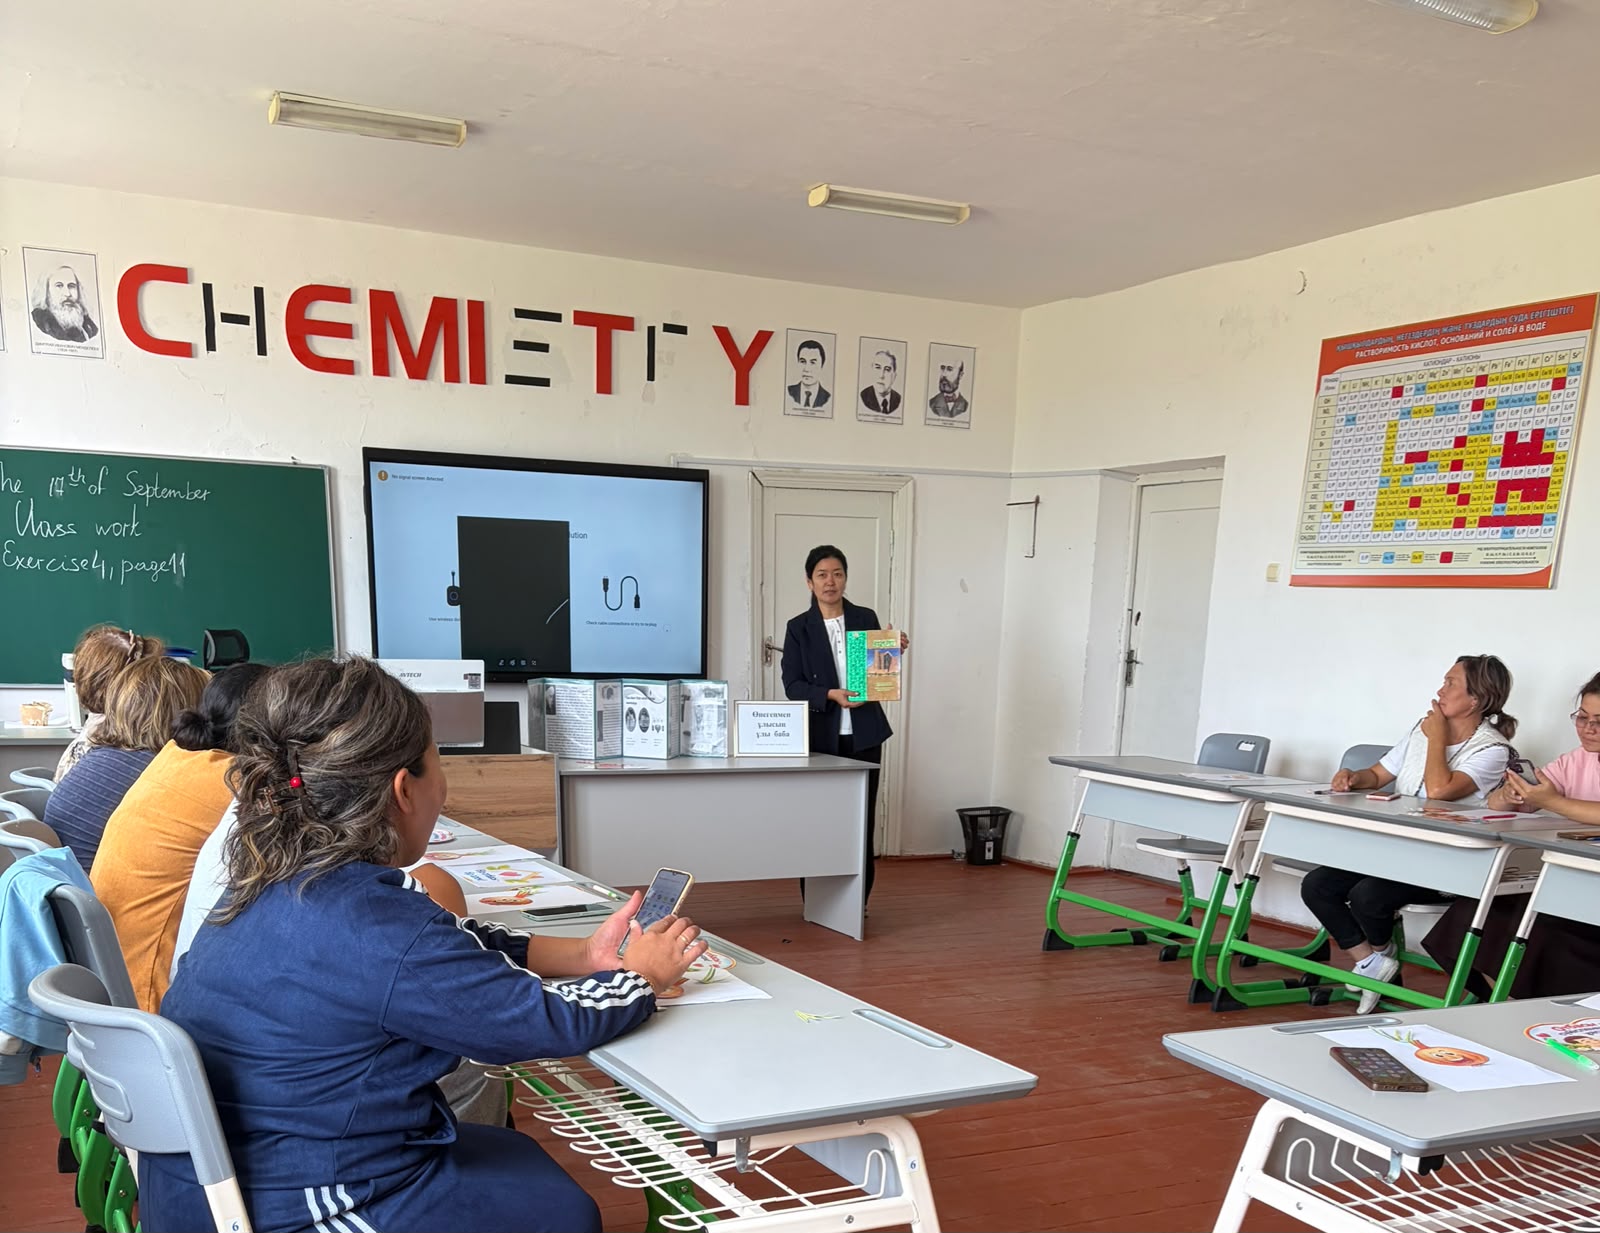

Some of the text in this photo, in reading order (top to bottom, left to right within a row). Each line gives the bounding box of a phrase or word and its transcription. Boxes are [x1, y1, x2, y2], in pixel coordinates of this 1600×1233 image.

[1508, 313, 1528, 323] СУДА
[1355, 344, 1408, 358] РАСТВОРИМОСТЬ
[1410, 338, 1439, 350] КИСЛОТ,
[1440, 330, 1484, 345] ОСНОВАНИЙ
[1492, 325, 1517, 337] СОЛЕЙ
[1526, 321, 1547, 331] ВОДЕ
[0, 461, 24, 493] he
[88, 466, 109, 495] of
[122, 470, 210, 507] September
[95, 504, 142, 538] work
[910, 1160, 917, 1170] 6
[232, 1221, 239, 1232] 6
